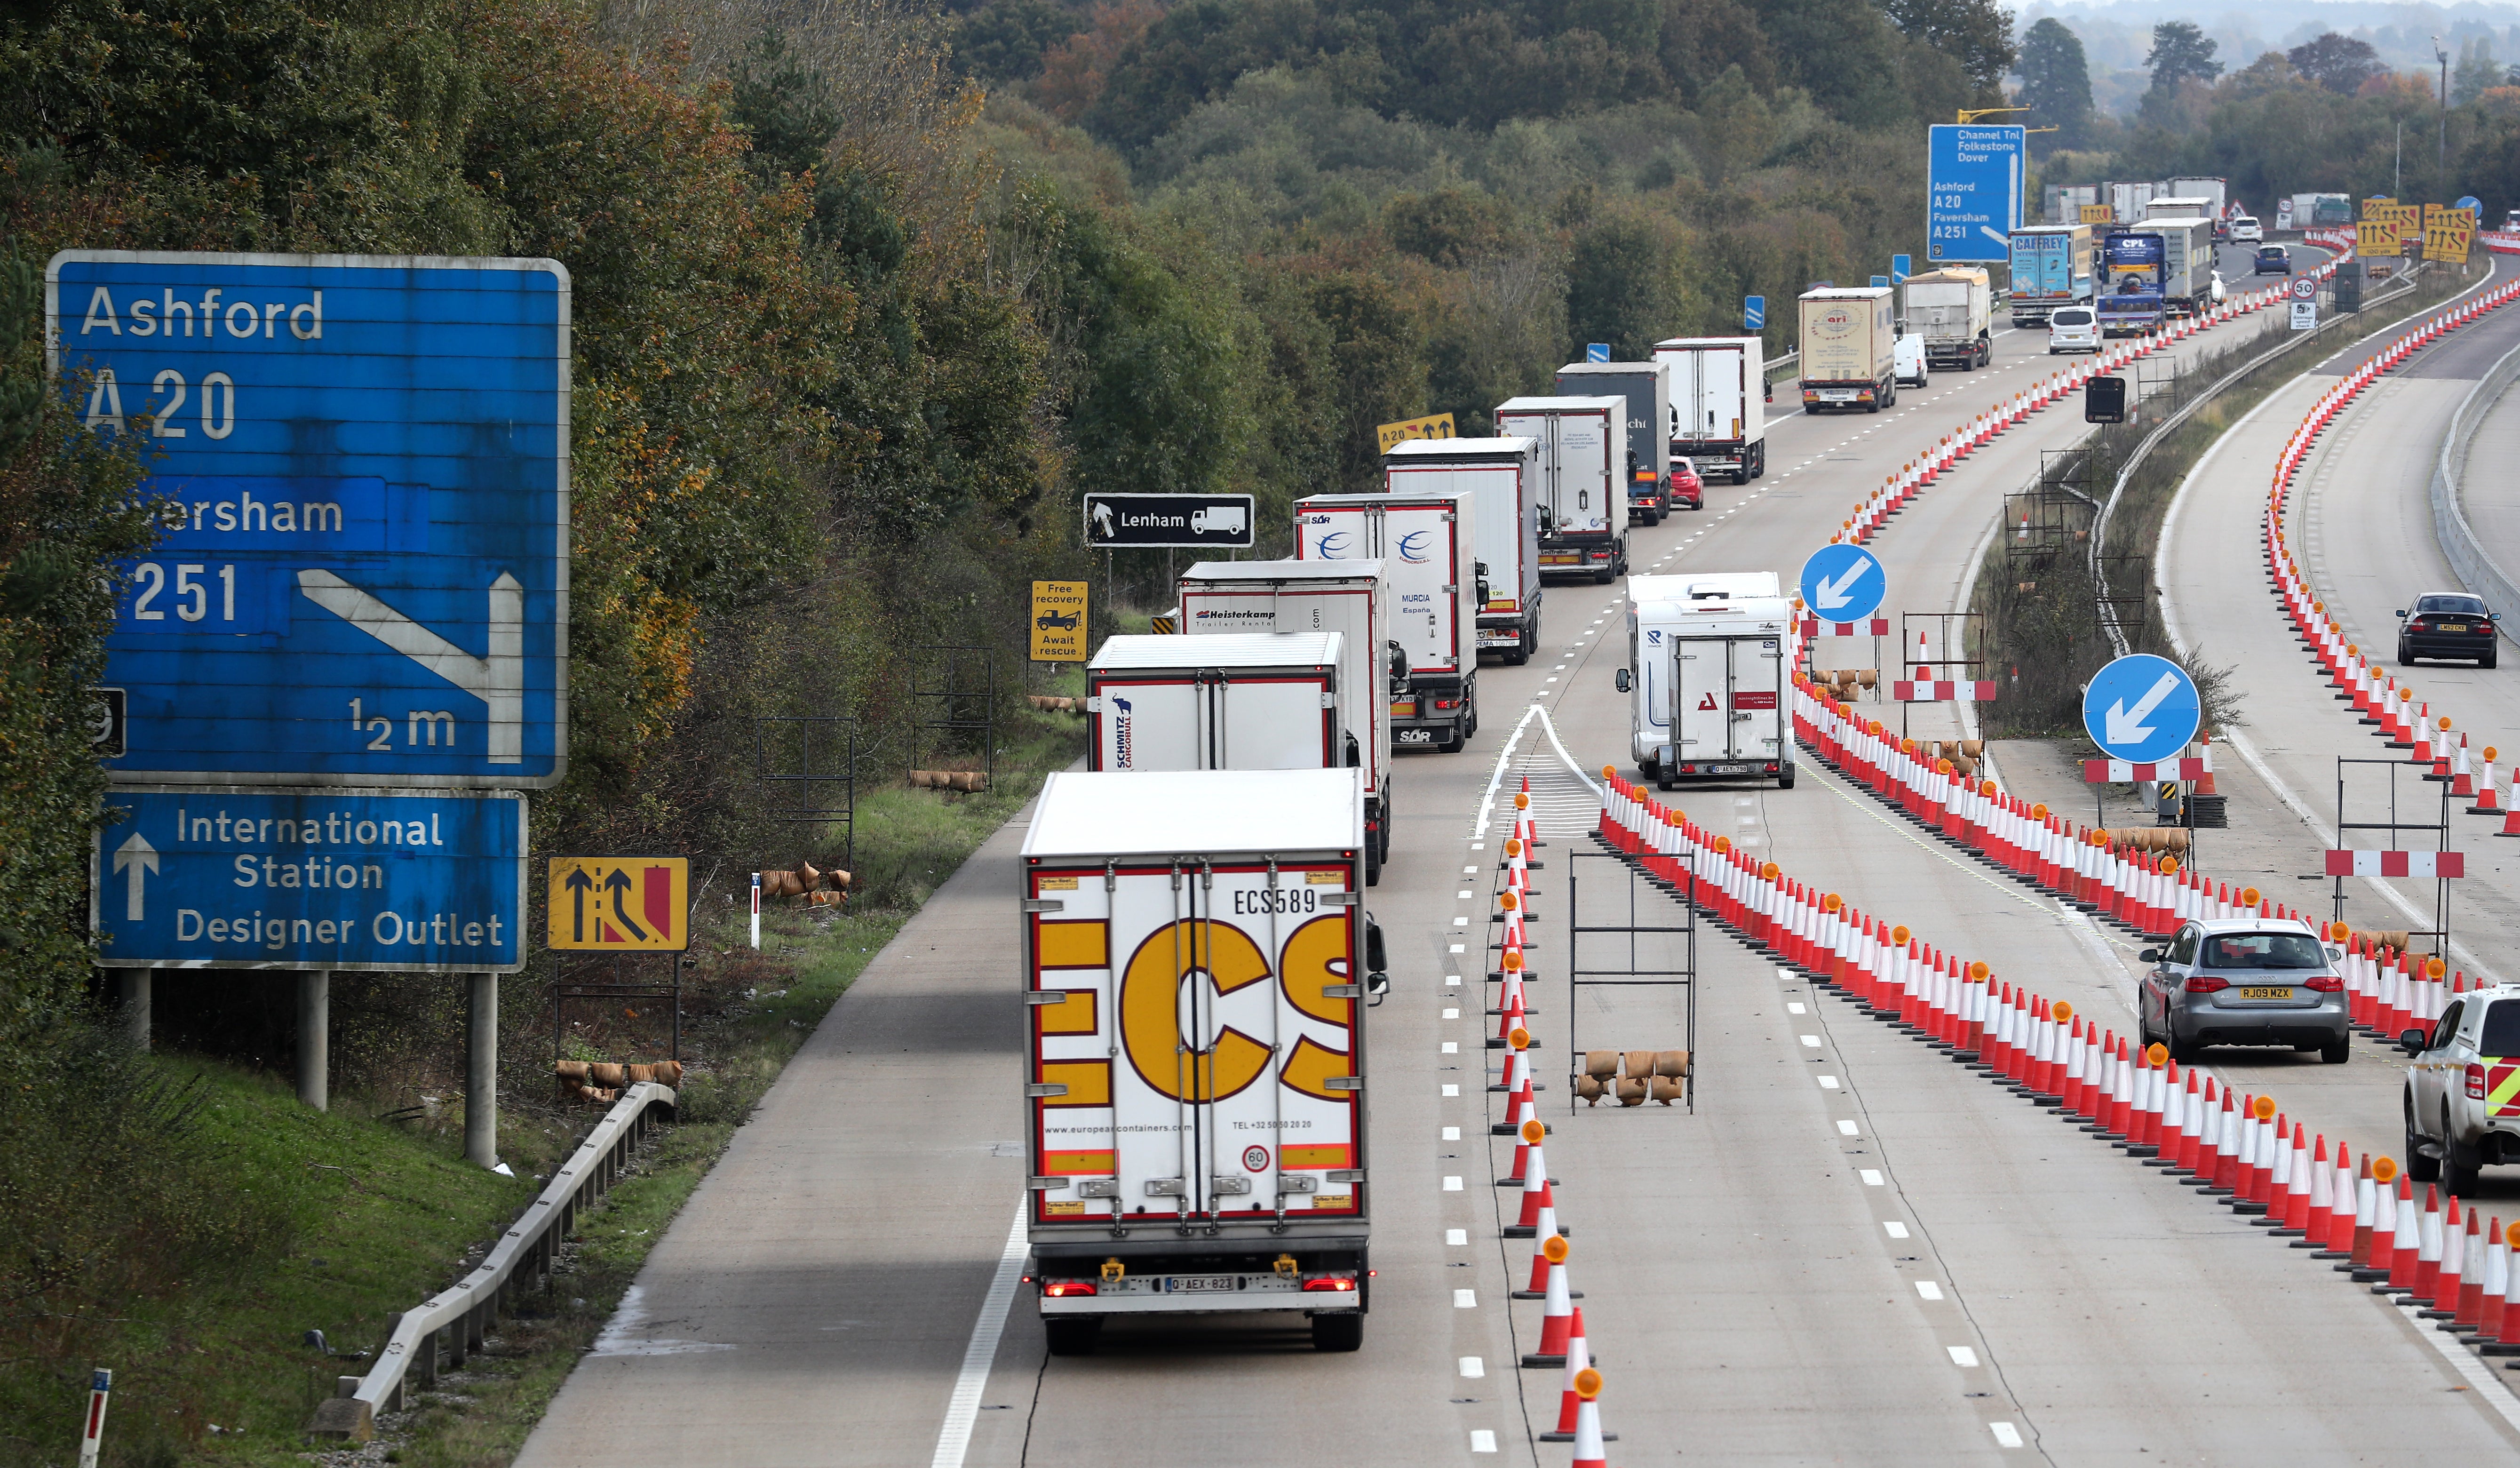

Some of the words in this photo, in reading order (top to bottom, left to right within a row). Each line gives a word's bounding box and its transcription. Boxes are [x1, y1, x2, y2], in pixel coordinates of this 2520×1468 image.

[1958, 130, 2001, 139] Channel
[2003, 130, 2020, 140] Tnl
[1958, 141, 2016, 151] Folkestone
[1958, 152, 1988, 162] Dover
[1934, 182, 1975, 191] Ashford
[1933, 213, 1989, 223] Faversham
[2015, 237, 2064, 251] CAFFREY
[2122, 239, 2146, 248] CPL
[1933, 245, 1941, 255] 9
[2296, 283, 2313, 293] 50
[80, 286, 323, 341] Ashford
[85, 367, 126, 435] A
[151, 369, 235, 440] 20
[1383, 432, 1389, 443] A
[1391, 430, 1405, 441] 20
[1121, 512, 1184, 527] Lenham
[135, 562, 235, 622] 251
[1048, 584, 1072, 593] Free
[1036, 596, 1083, 605] recovery
[1210, 610, 1276, 620] Heisterkamp
[1042, 636, 1074, 645] Await
[1116, 716, 1125, 768] SCHMITZ
[177, 808, 443, 846] International
[232, 854, 383, 890] Station
[1234, 889, 1315, 914] ECS589
[176, 908, 355, 950] Designer
[373, 911, 503, 947] Outlet
[2243, 989, 2268, 997] RJ09
[2270, 989, 2289, 997] MZX
[1040, 913, 1350, 1109] ECS
[1248, 1152, 1263, 1162] 60
